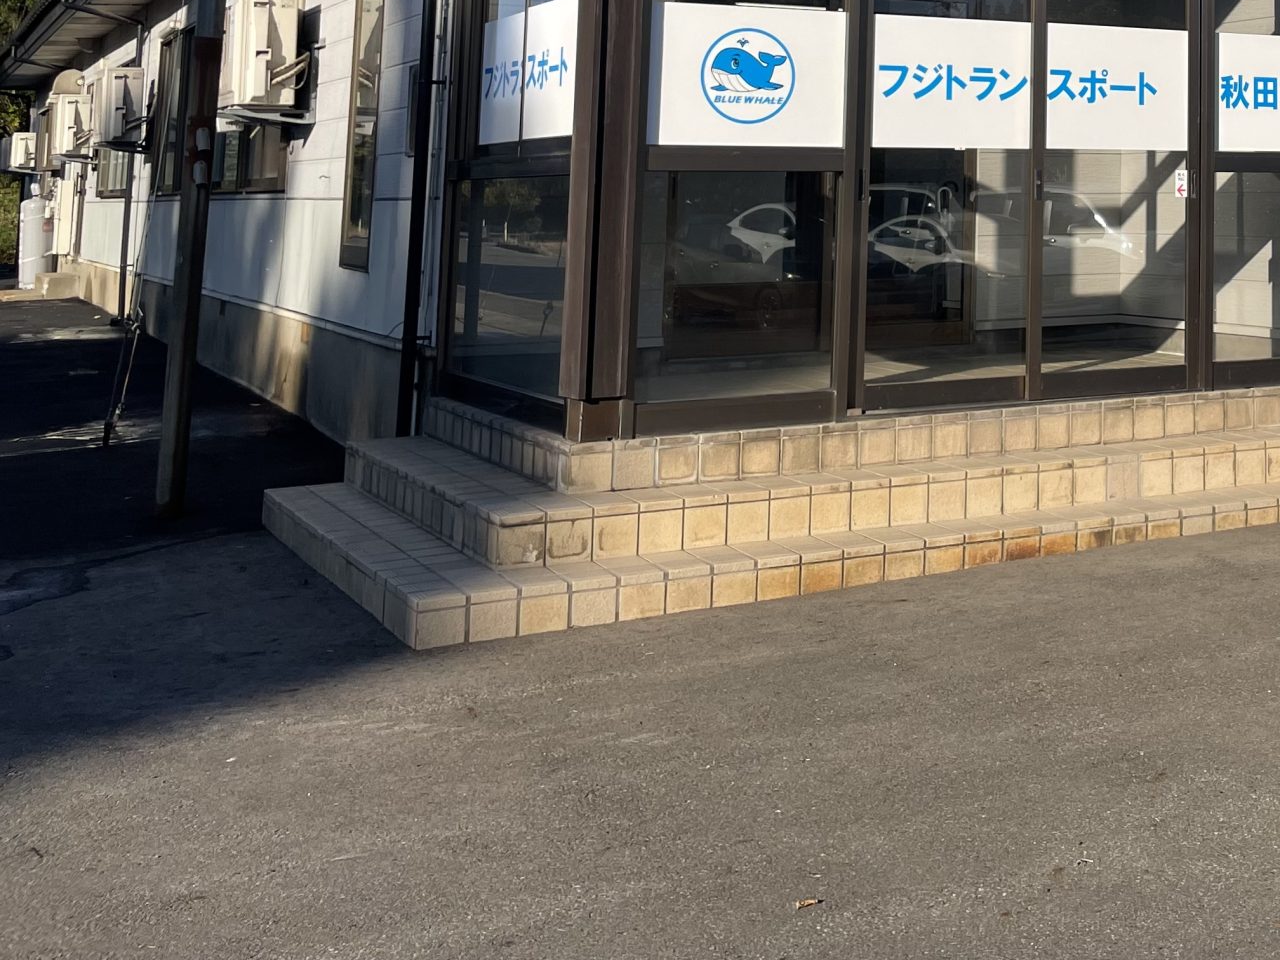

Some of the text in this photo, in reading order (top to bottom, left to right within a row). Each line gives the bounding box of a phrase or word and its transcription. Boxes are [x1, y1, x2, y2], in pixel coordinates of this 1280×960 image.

[484, 46, 568, 100] フジトラスポート
[714, 95, 784, 105] BLUE WHALE
